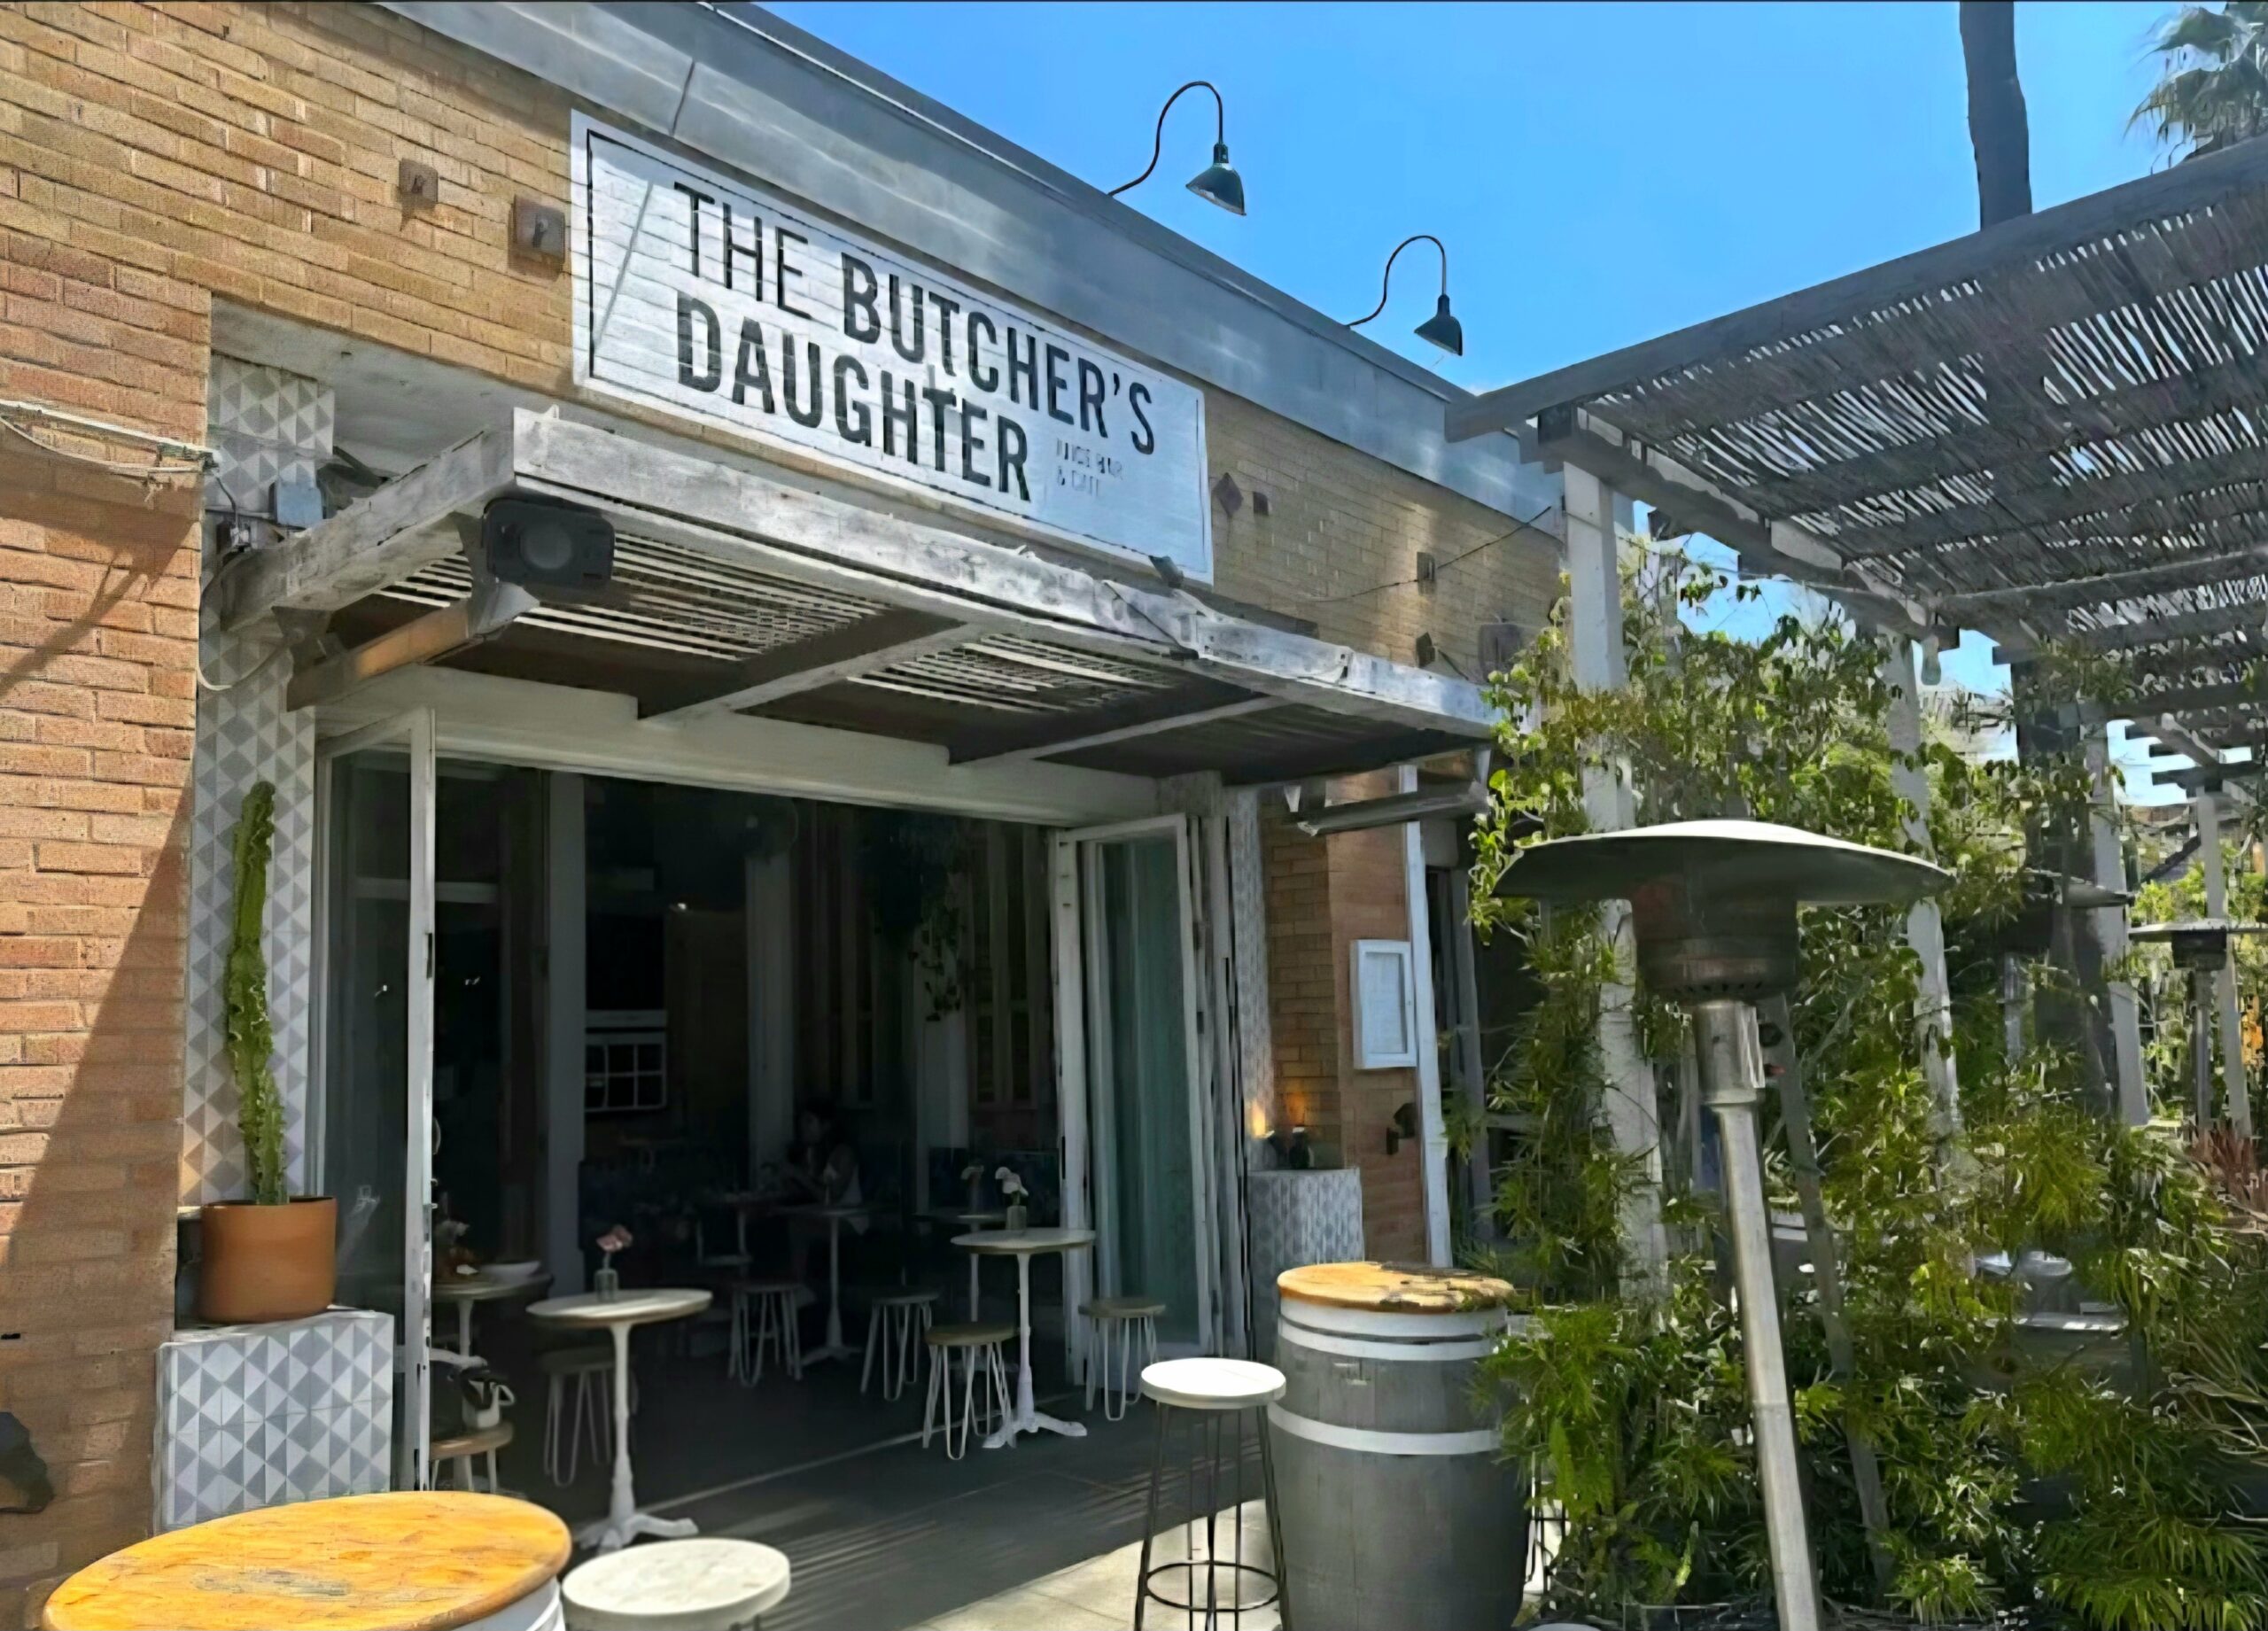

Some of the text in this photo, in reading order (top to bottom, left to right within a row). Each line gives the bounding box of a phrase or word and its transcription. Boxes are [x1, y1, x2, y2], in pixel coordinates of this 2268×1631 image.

[674, 182, 1154, 455] THE BUTCHER'S
[677, 291, 1030, 501] DAUGHTER
